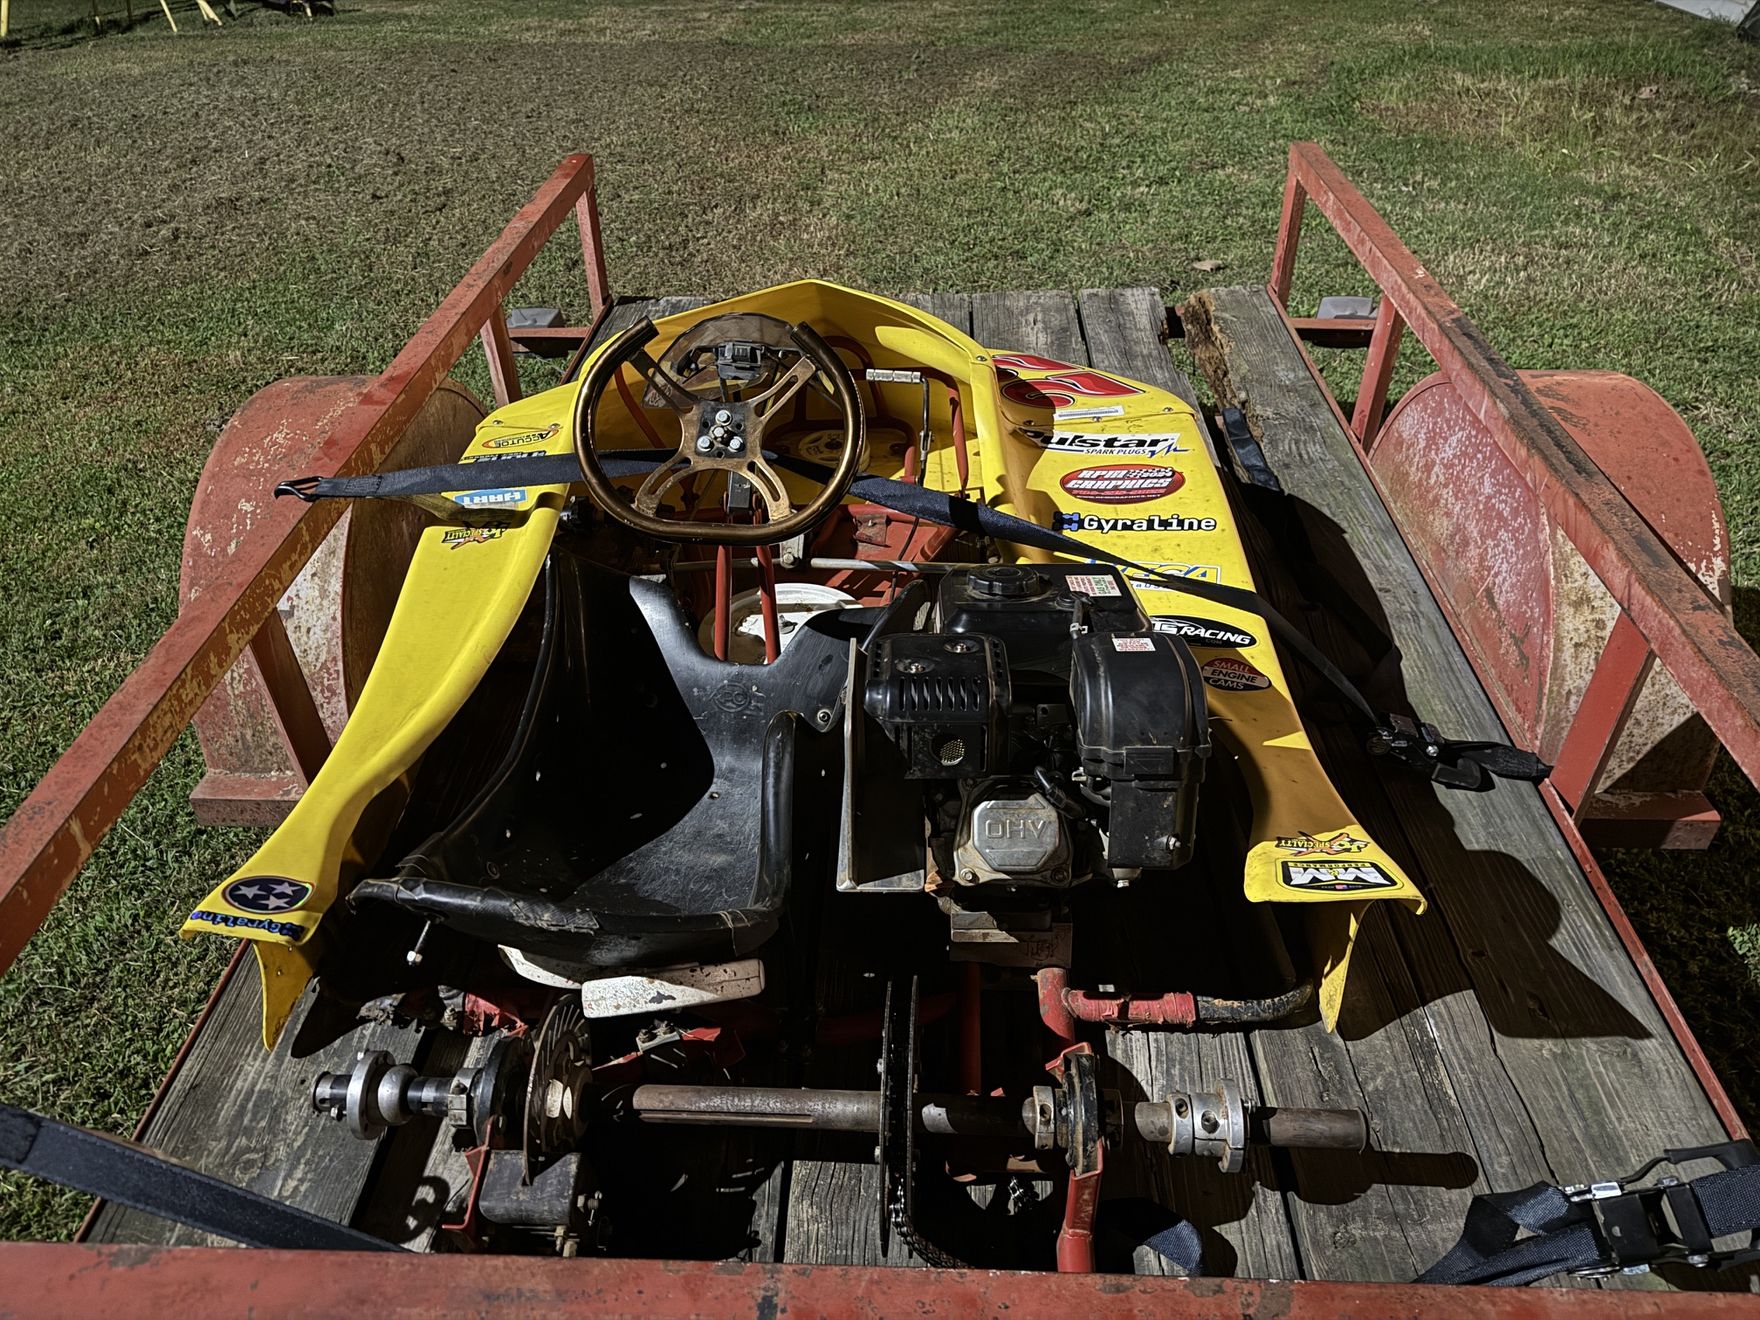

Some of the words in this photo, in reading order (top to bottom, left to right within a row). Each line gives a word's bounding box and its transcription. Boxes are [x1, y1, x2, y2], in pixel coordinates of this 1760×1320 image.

[1078, 470, 1127, 479] RPM
[1063, 478, 1173, 490] GRAPHICS
[464, 492, 520, 504] HART
[1083, 515, 1216, 533] Gyraline
[1180, 625, 1251, 646] RACING
[1213, 660, 1251, 673] SMALL
[1210, 669, 1258, 684] ENGINE
[1208, 678, 1244, 690] CAMS
[985, 819, 1046, 839] OHV
[1279, 839, 1331, 849] SPECIALTY
